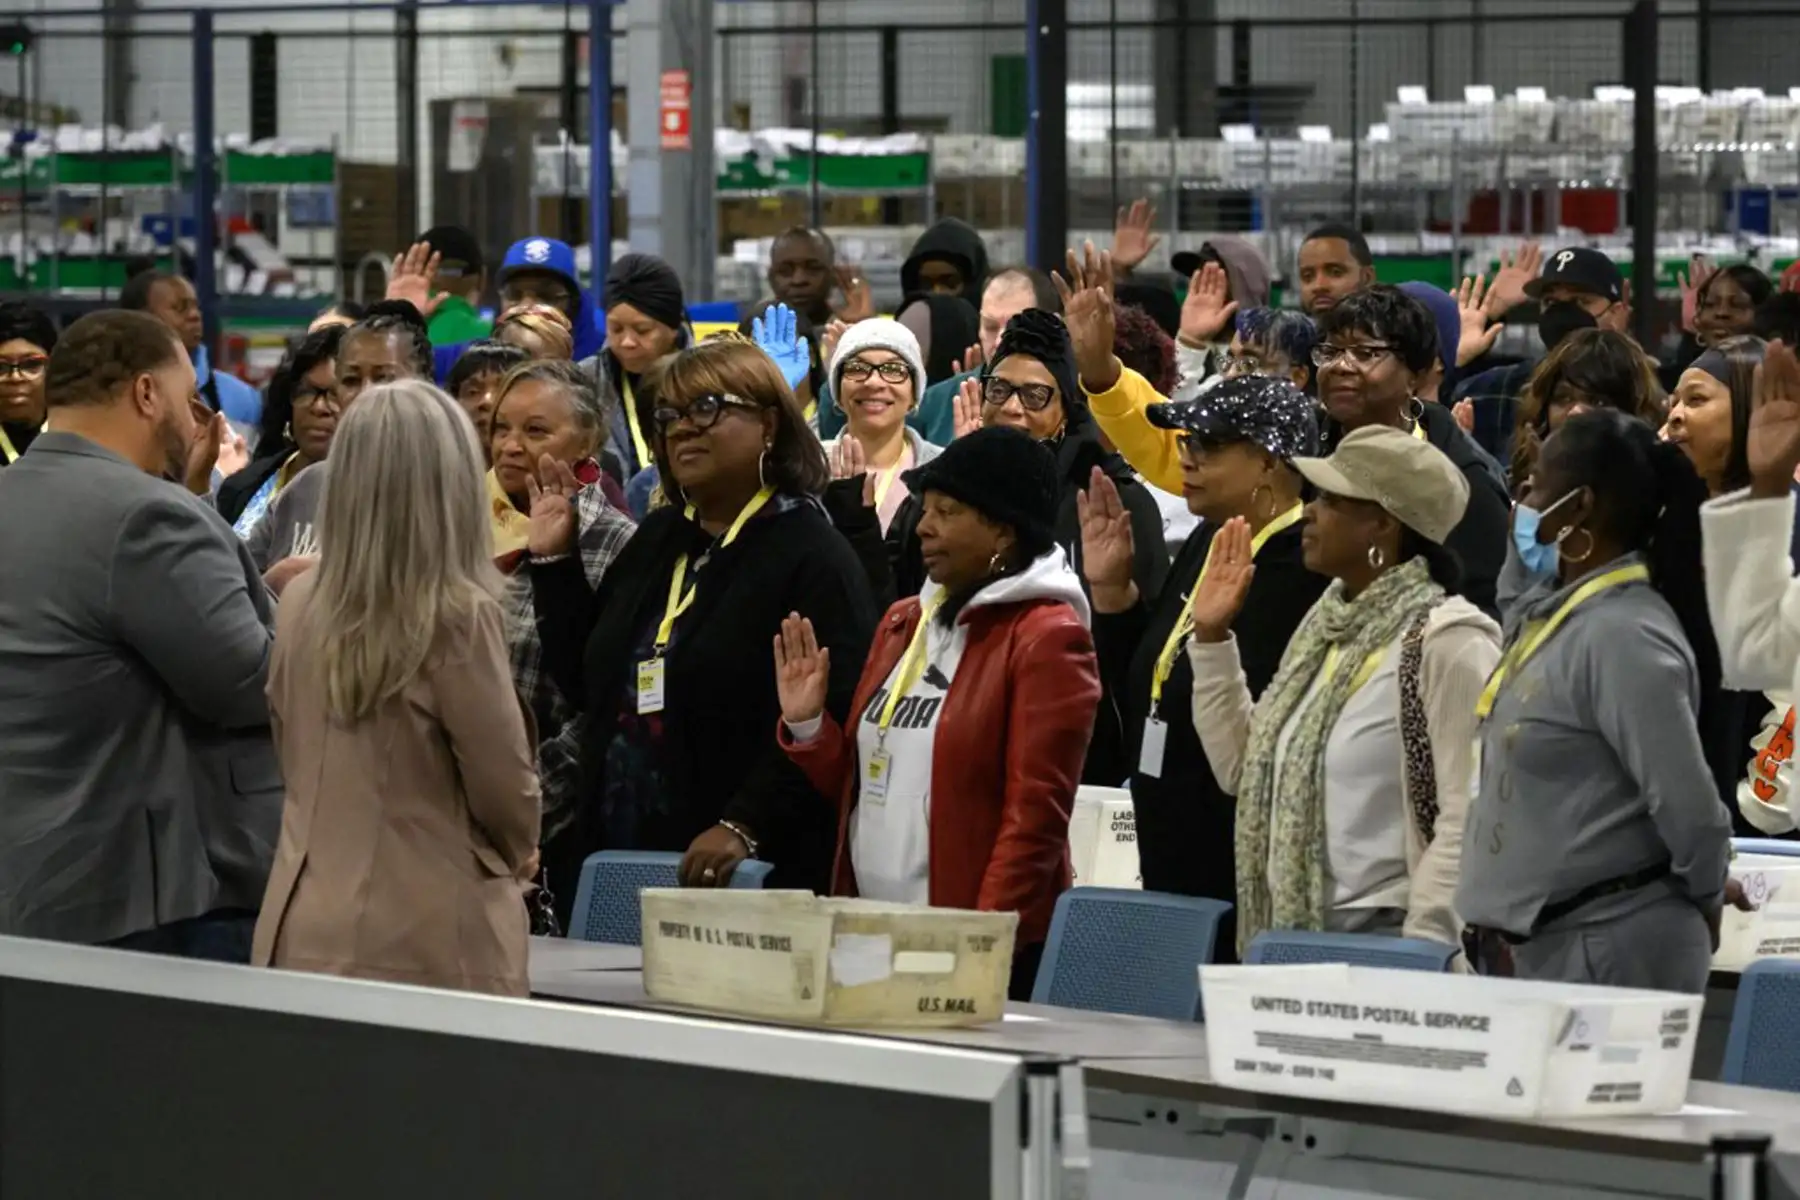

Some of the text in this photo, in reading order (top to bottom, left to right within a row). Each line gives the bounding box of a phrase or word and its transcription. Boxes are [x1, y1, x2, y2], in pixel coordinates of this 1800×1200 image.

[1556, 250, 1576, 273] P
[863, 687, 943, 729] UMA
[1110, 821, 1137, 832] OTHE
[1115, 833, 1136, 842] END
[726, 929, 756, 949] POSTAL
[759, 934, 792, 953] SERVICE
[944, 999, 977, 1014] MAIL
[1251, 995, 1490, 1032] UNITED STATES POSTAL SERVICE
